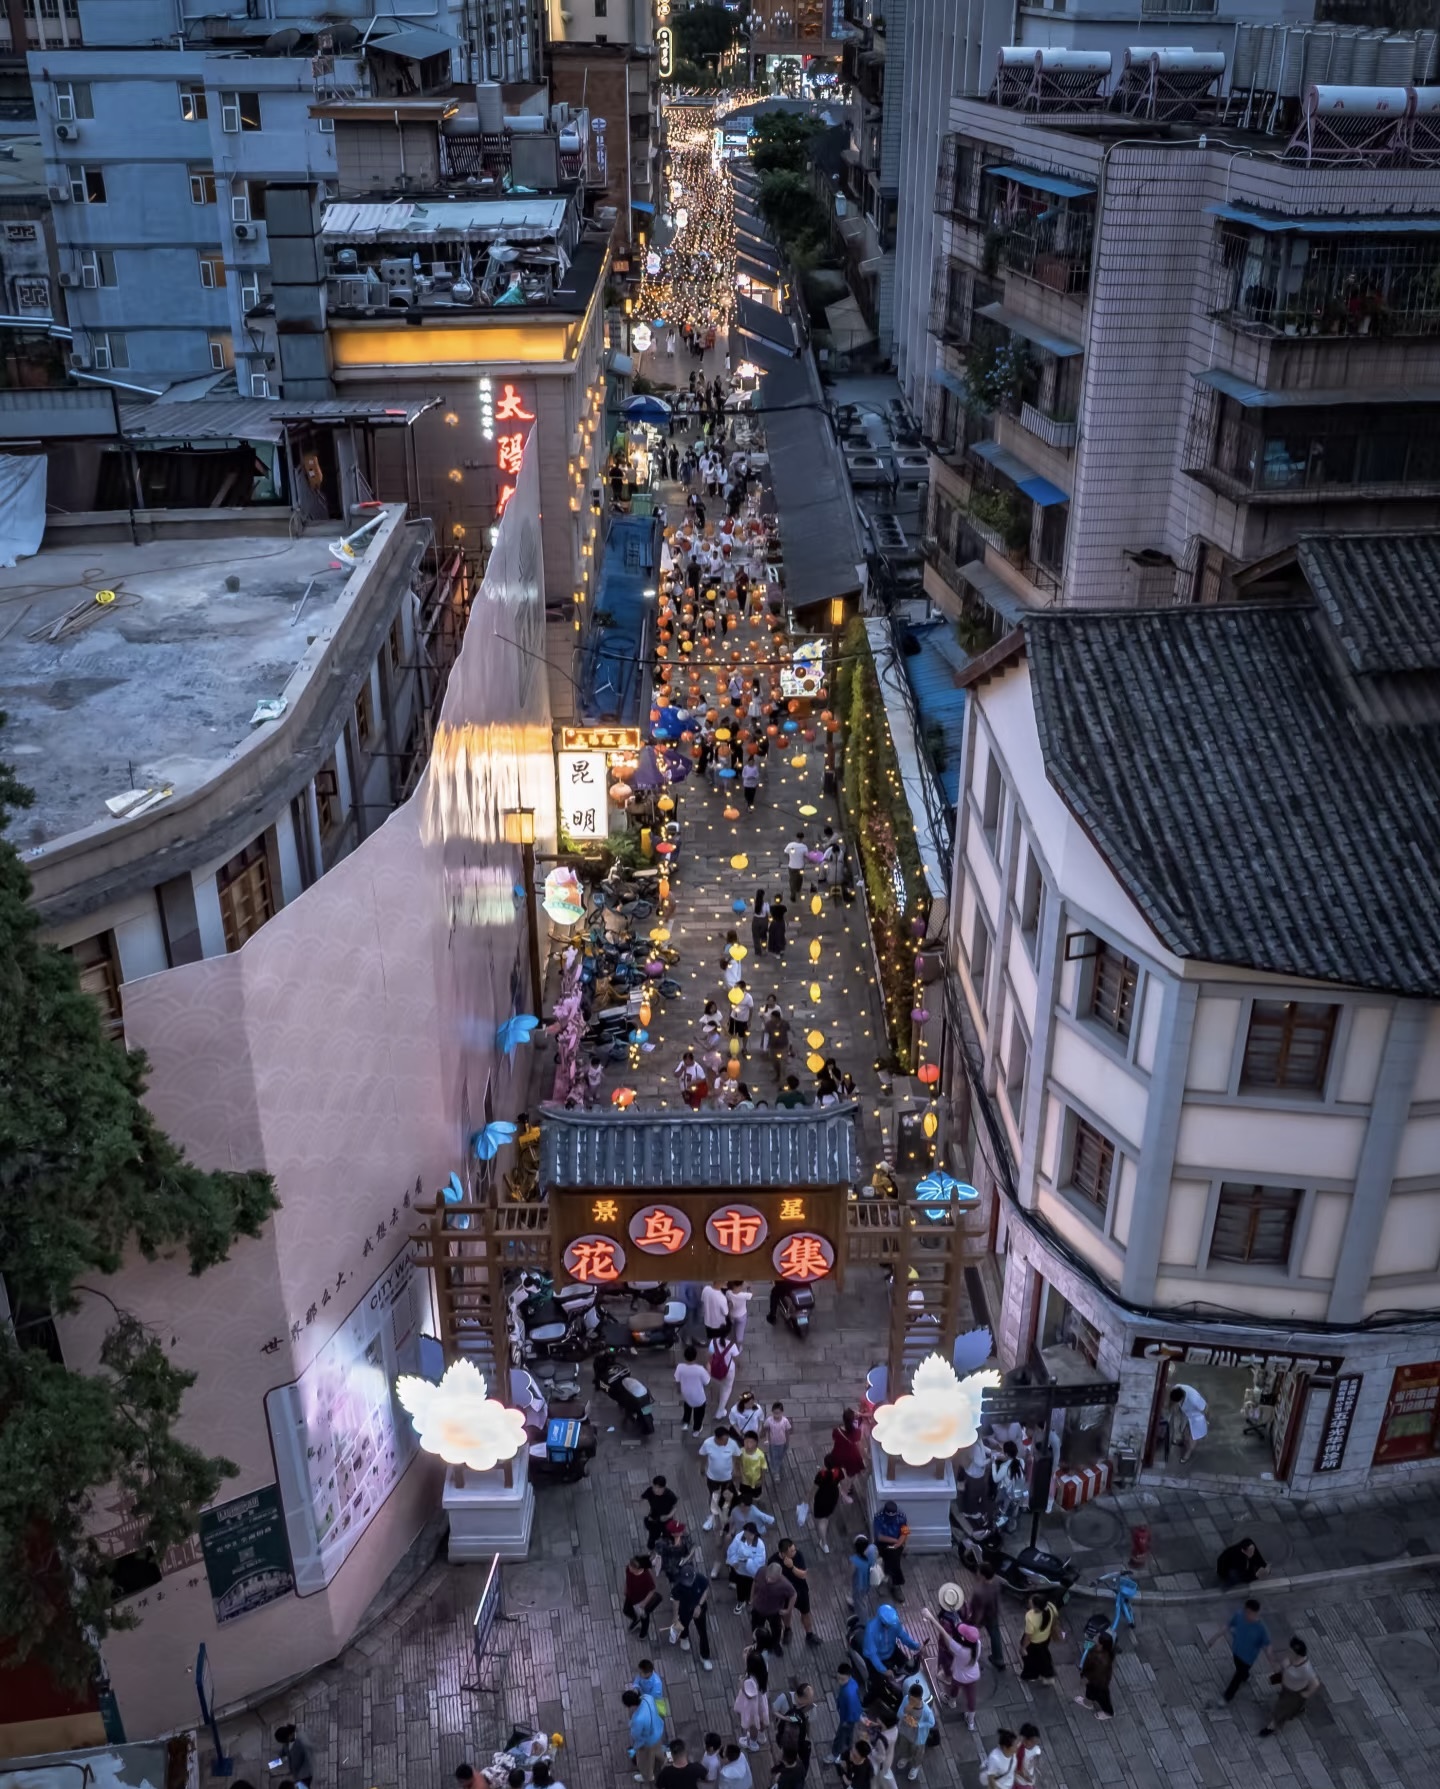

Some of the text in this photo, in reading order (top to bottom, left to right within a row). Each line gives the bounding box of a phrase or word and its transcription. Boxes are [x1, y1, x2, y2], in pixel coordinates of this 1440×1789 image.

[571, 759, 595, 833] 昆明
[592, 1199, 805, 1221] 景 星
[569, 1209, 830, 1281] 花鸟市集
[370, 1275, 393, 1309] CITY
